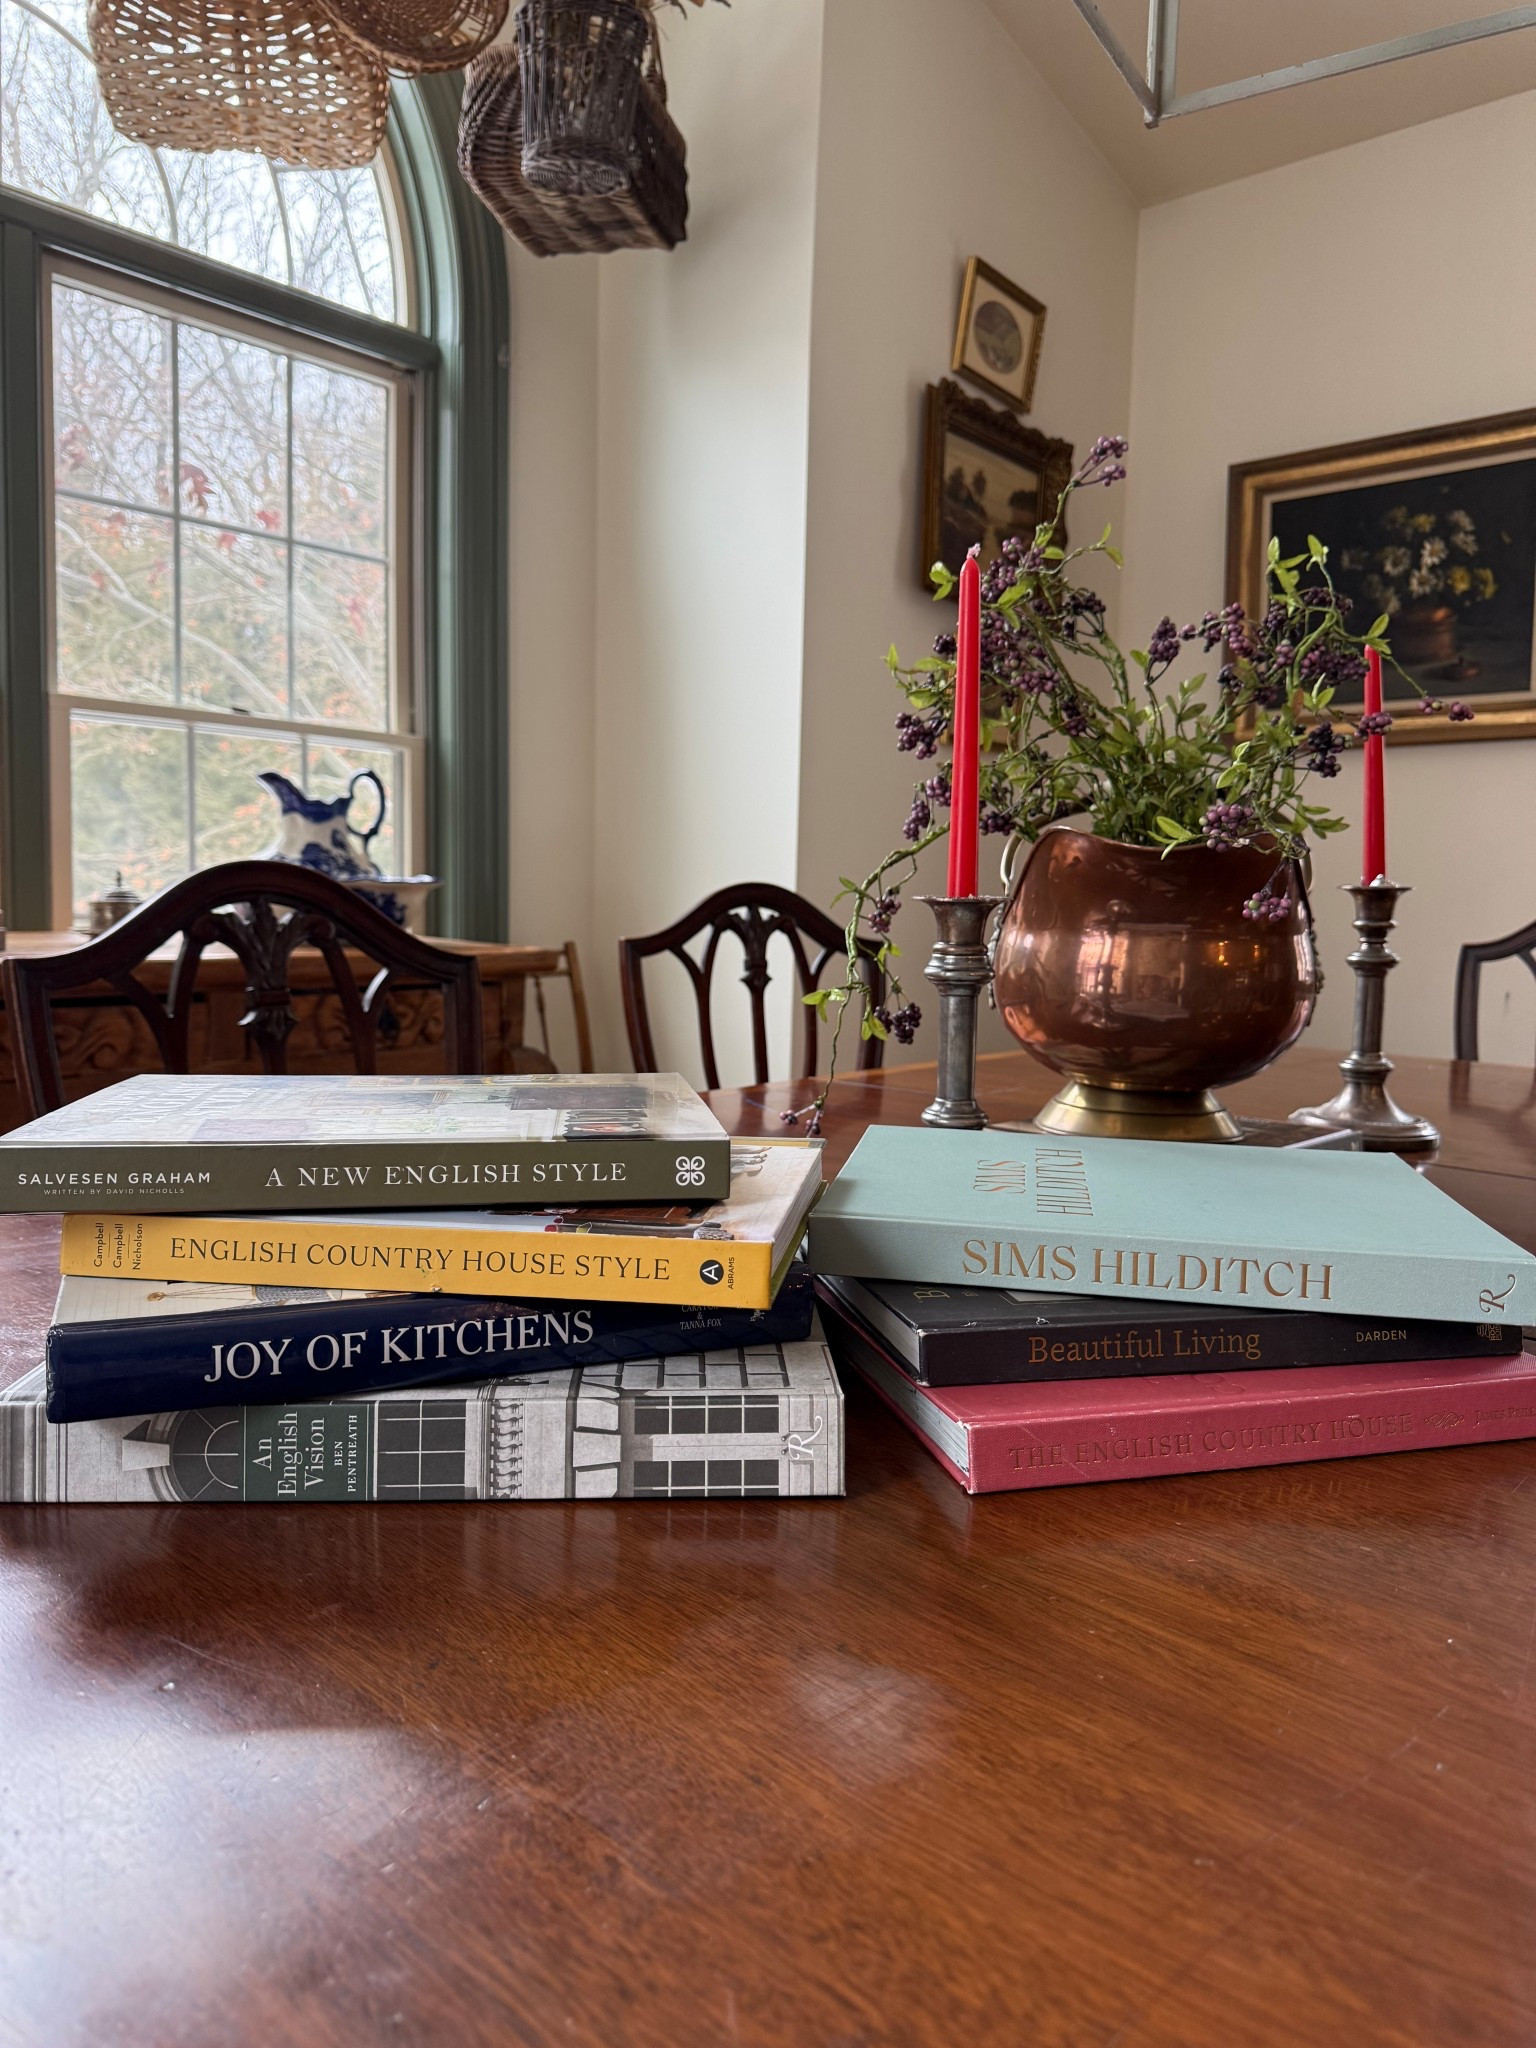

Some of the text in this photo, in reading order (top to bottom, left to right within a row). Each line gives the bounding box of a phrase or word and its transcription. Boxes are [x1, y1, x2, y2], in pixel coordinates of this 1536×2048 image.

[18, 1172, 211, 1185] SALVESEN GRAHAM
[265, 1162, 627, 1187] A NEW ENGLISH STYLE
[973, 1159, 1026, 1194] SIMS
[1036, 1148, 1093, 1216] HILDITCH
[93, 1222, 106, 1267] Campbell
[113, 1223, 126, 1268] Campbell
[132, 1223, 143, 1270] Nicholson
[170, 1237, 670, 1281] ENGLISH COUNTRY HOUSE STYLE
[727, 1256, 735, 1290] ABRAMS
[962, 1239, 1333, 1300] SIMS HILDITCH
[1479, 1273, 1516, 1313] R
[204, 1310, 594, 1383] JOY OF KITCHENS
[680, 1318, 722, 1331] TANNA FOX
[1029, 1328, 1262, 1363] Beautiful Living
[1356, 1329, 1407, 1343] DARDEN
[252, 1437, 272, 1471] An
[277, 1411, 303, 1497] English
[304, 1417, 325, 1490] Vision
[334, 1441, 343, 1466] BEN
[347, 1415, 357, 1492] PENTREATH
[1009, 1414, 1414, 1470] THE ENGLISH COUNTRY HOUSE
